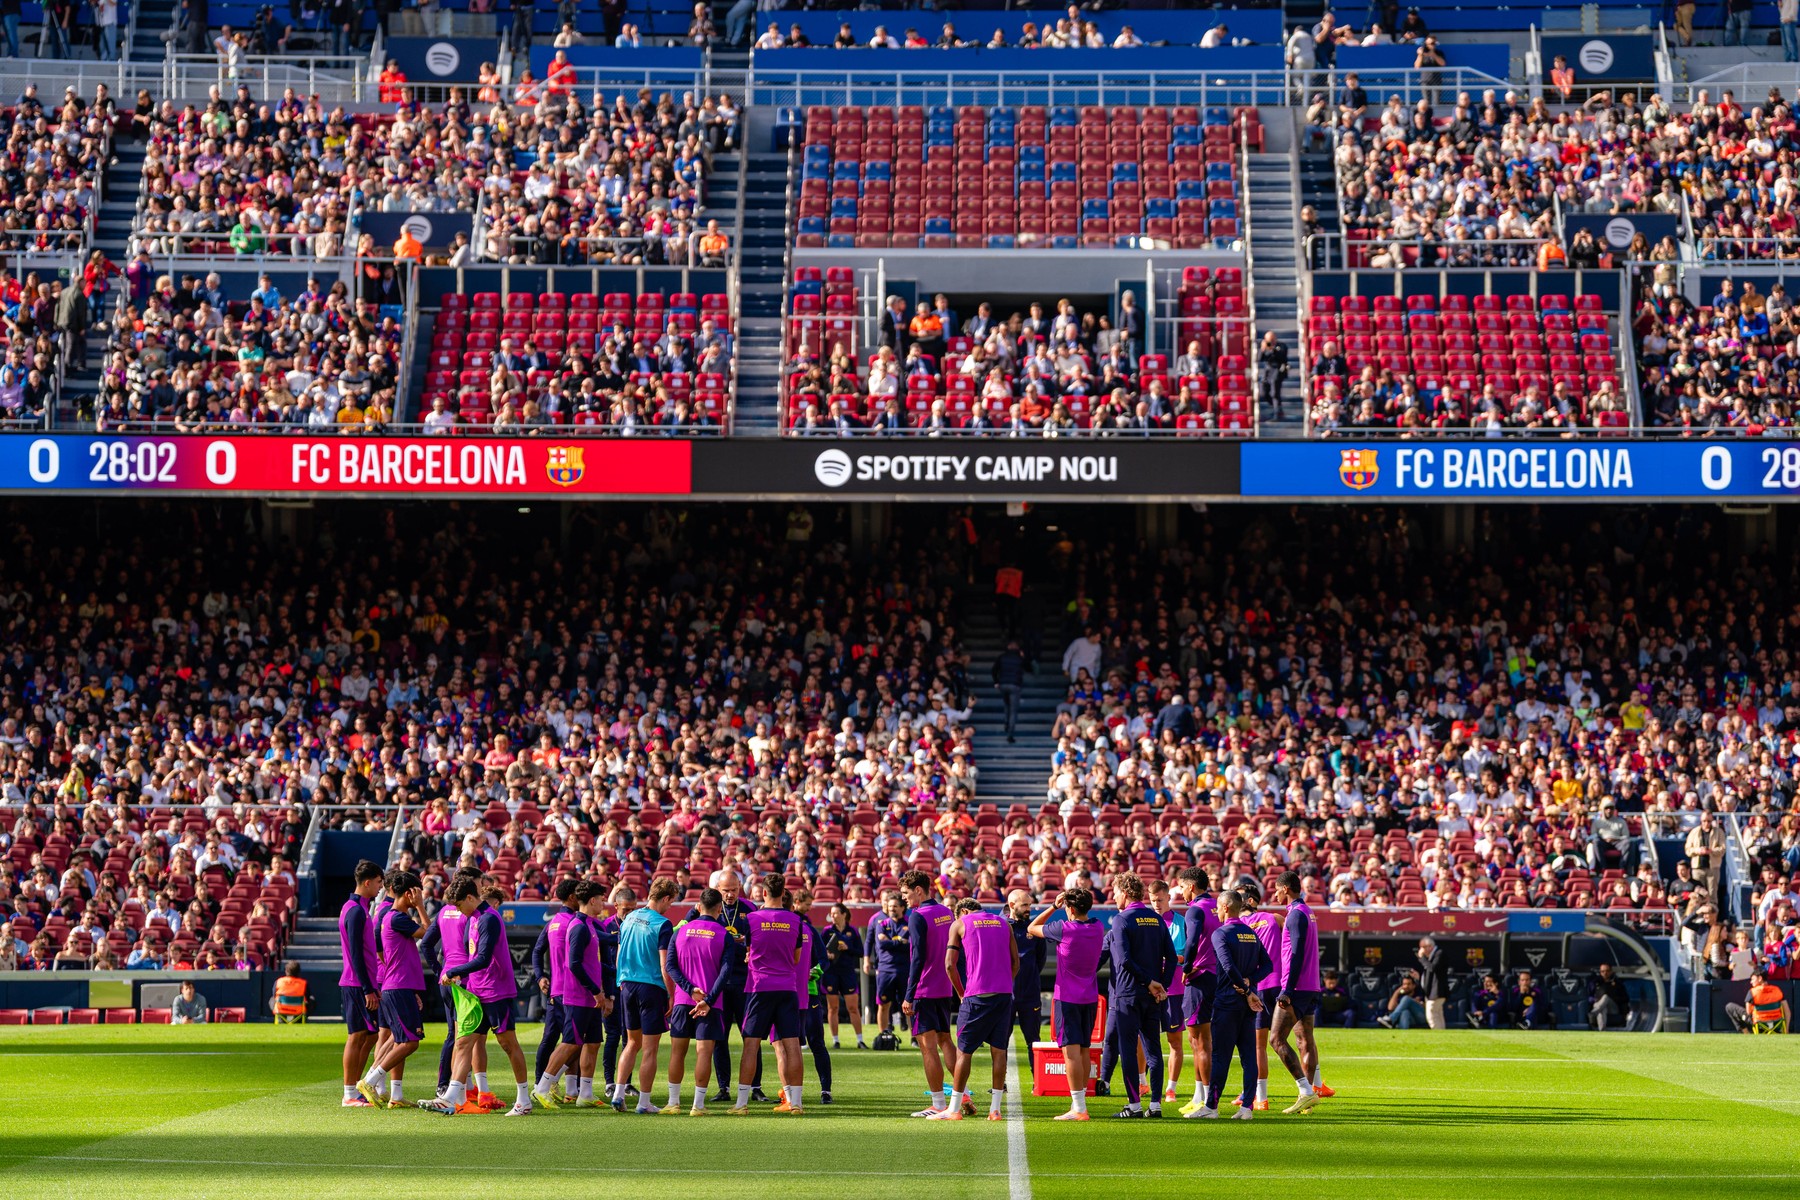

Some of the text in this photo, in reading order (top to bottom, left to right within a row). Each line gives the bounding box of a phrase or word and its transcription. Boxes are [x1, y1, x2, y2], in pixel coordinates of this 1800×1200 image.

[29, 438, 527, 484] 0 28:02 0 FC BARCELONA
[856, 456, 1118, 482] SPOTIFY CAMP NOU
[1396, 445, 1800, 489] FC BARCELONA 0 28
